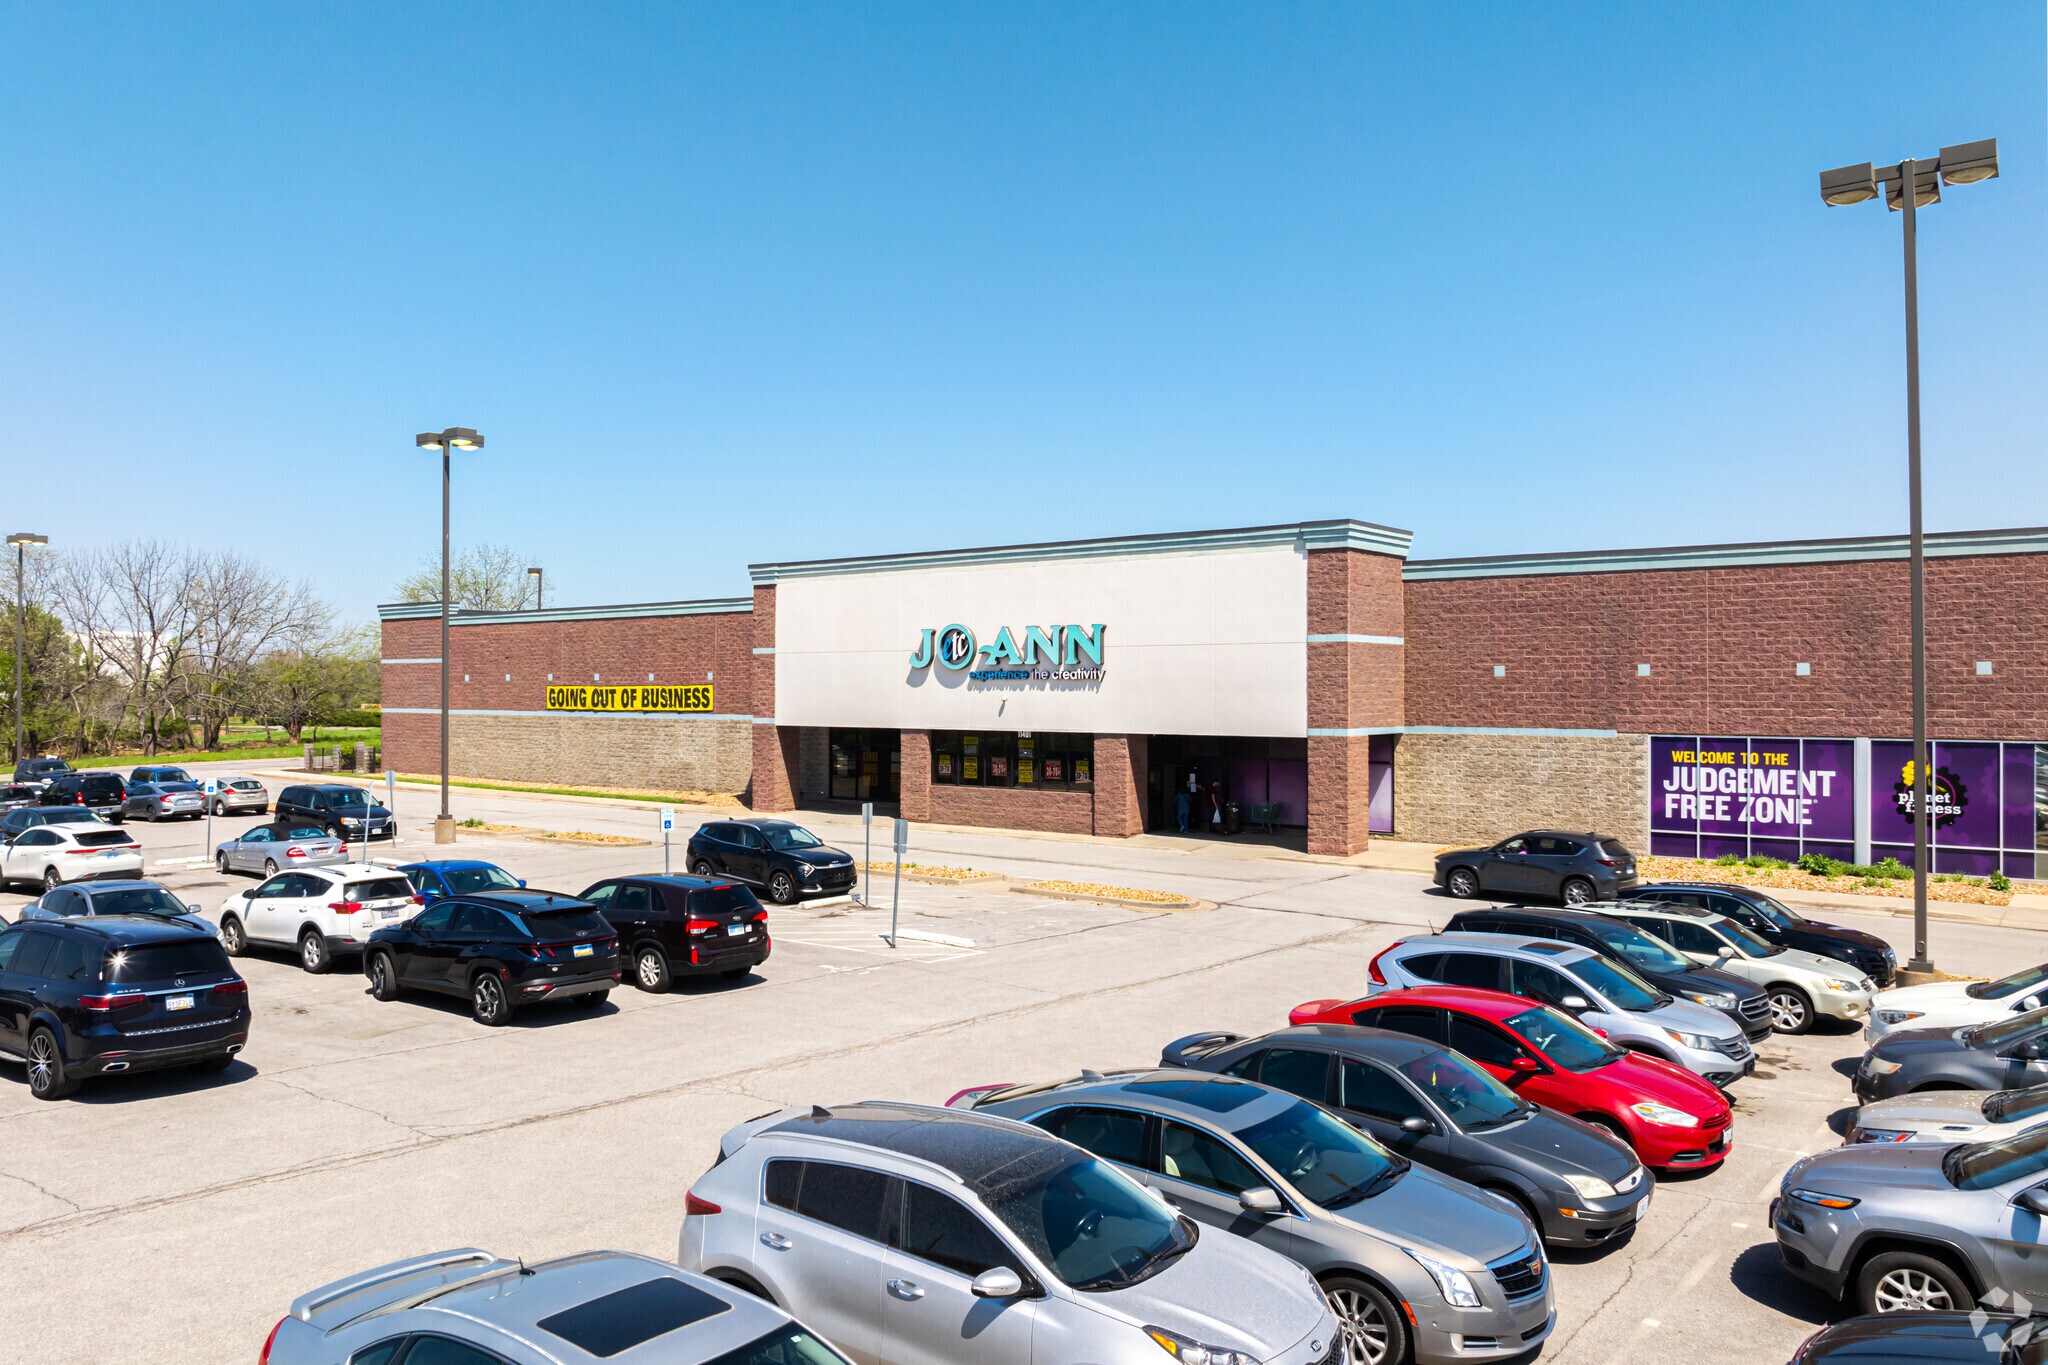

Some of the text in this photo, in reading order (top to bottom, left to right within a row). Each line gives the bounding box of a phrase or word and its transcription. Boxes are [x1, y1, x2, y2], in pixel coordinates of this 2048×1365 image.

[969, 669, 1106, 682] experience the creativity
[549, 687, 710, 709] GOING OUT OF BUSINESS
[1672, 750, 1789, 766] WELCOME TO THE
[1663, 766, 1836, 797] JUDGEMENT
[1898, 791, 1951, 805] plnet
[1665, 793, 1813, 825] FREE ZONE
